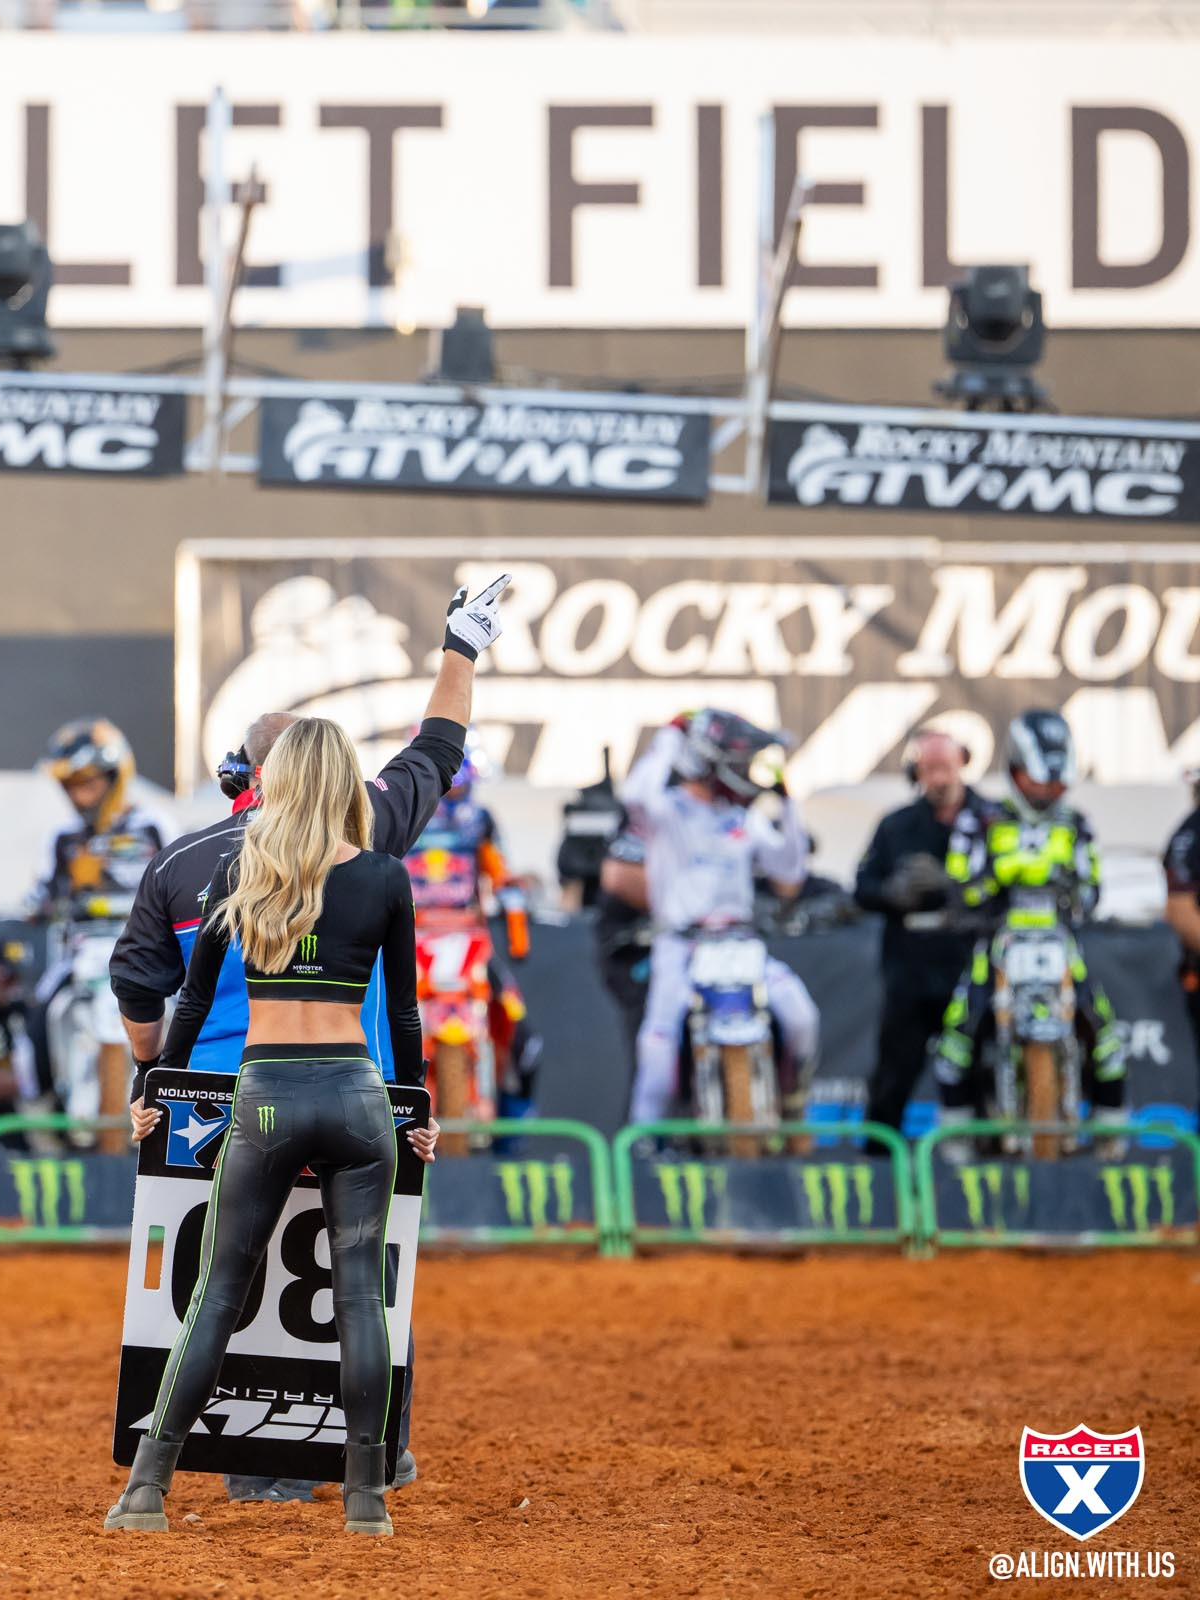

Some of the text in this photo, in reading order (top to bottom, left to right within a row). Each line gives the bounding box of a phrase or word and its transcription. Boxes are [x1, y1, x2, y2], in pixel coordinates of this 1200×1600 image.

[547, 104, 1191, 290] FIELD
[349, 397, 687, 446] ROCKY MOUNTAIN
[853, 420, 1187, 472] ROCKY MOUNTAIN
[426, 561, 895, 676] ROCKY
[157, 1086, 235, 1101] SSOCIATION
[215, 1385, 335, 1404] RACIN
